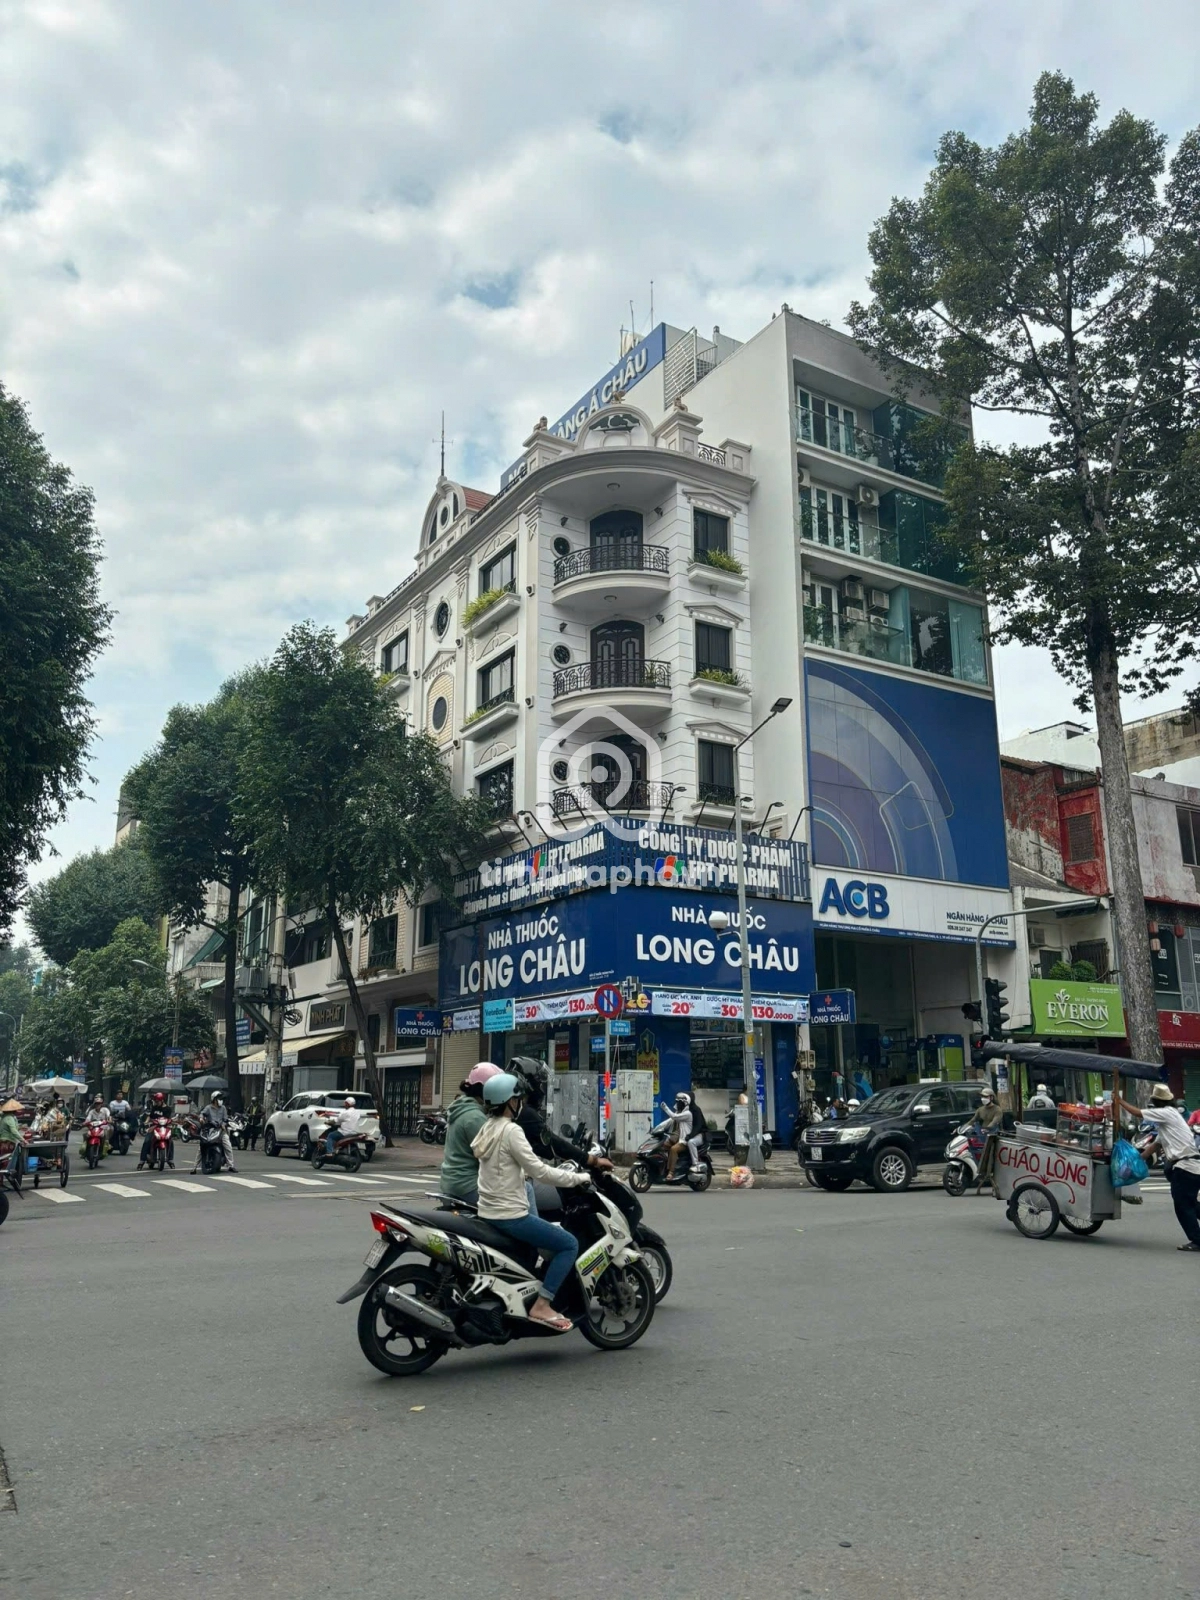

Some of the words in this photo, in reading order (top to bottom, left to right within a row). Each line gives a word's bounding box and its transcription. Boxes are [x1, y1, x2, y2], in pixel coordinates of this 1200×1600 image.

[553, 405, 588, 440] ÀNG
[589, 389, 601, 416] Á
[601, 347, 648, 403] CHÂU
[548, 846, 564, 869] FPT
[564, 831, 605, 862] PHARMA
[639, 826, 681, 853] CÔNG
[684, 836, 704, 857] TY
[750, 843, 791, 867] PHẨM
[688, 859, 715, 881] FPT
[818, 878, 890, 919] ACB
[488, 921, 513, 950] NHÀ
[515, 907, 559, 944] THUỐC
[671, 904, 708, 925] NHÀ
[946, 910, 965, 921] NGÂN
[966, 912, 985, 923] HÀNG
[460, 954, 514, 996] LONG
[520, 933, 586, 984] CHÂU
[636, 934, 715, 966] LONG
[724, 938, 799, 972] CHÂU
[671, 1001, 695, 1014] 20%
[811, 1015, 829, 1024] LONG
[830, 1012, 849, 1023] CHÂU
[827, 1004, 841, 1012] THUỐC
[1046, 1001, 1109, 1021] EVERON
[398, 1027, 418, 1036] LONG
[420, 1026, 442, 1036] CHÂU
[997, 1146, 1040, 1173] CHÁO
[1046, 1152, 1088, 1186] LÒNG
